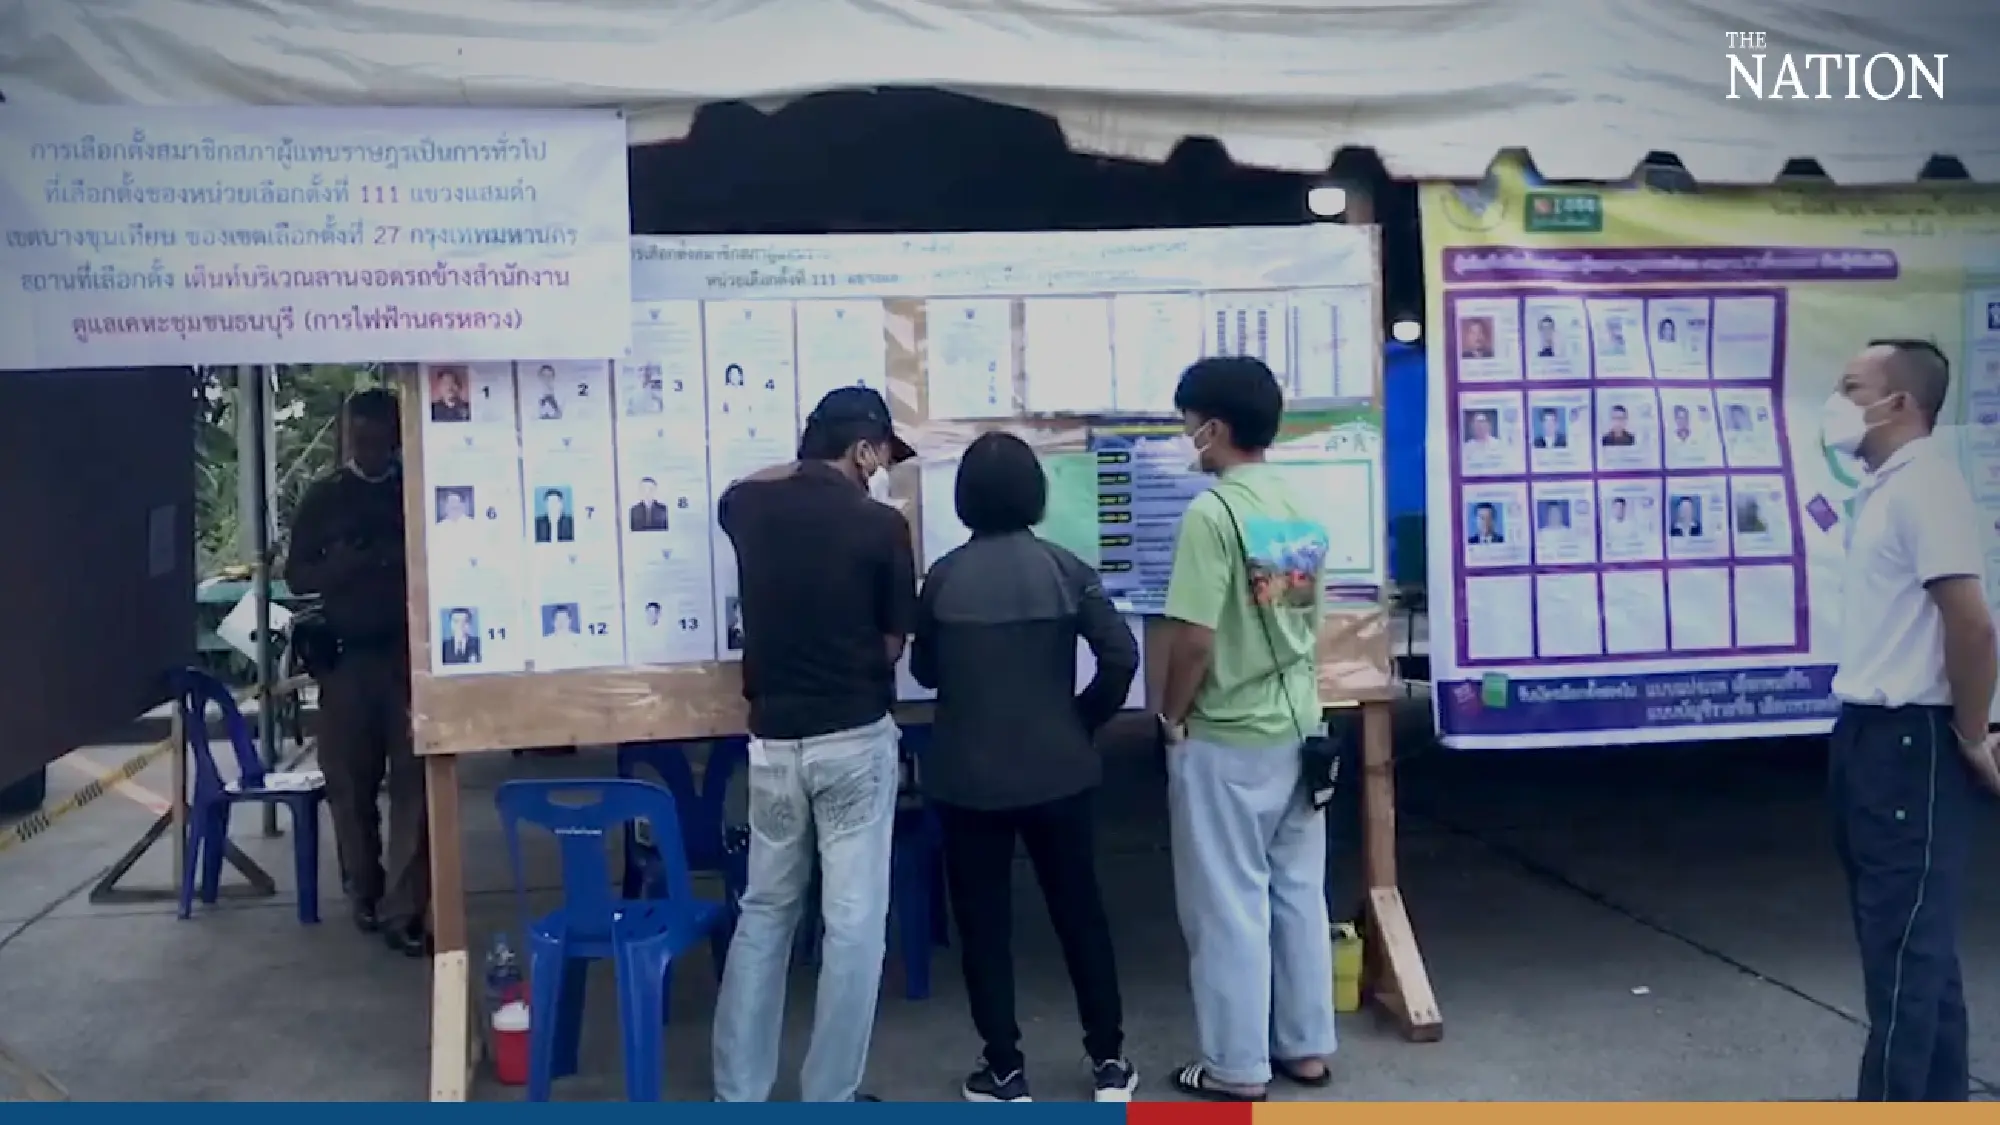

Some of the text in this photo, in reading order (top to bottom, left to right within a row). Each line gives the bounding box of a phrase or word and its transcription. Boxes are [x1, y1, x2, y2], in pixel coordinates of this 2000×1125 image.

[30, 128, 547, 170] การเลือกตั้งสมาชิกสภาผู้แทนราษฎรเป็นการทั่วไป
[44, 170, 349, 204] ที่เลือกตั้งของหน่วยเลือกตั้งที่
[361, 185, 399, 204] 111
[373, 225, 400, 245] 27
[812, 274, 836, 286] 111
[577, 383, 589, 396] 2
[673, 379, 684, 392] 3
[765, 379, 775, 390] 4
[482, 386, 490, 399] 1
[677, 496, 689, 509] 8
[486, 506, 497, 520] 6
[585, 506, 595, 519] 7
[588, 622, 608, 635] 12
[678, 618, 699, 631] 13
[488, 627, 506, 640] 11
